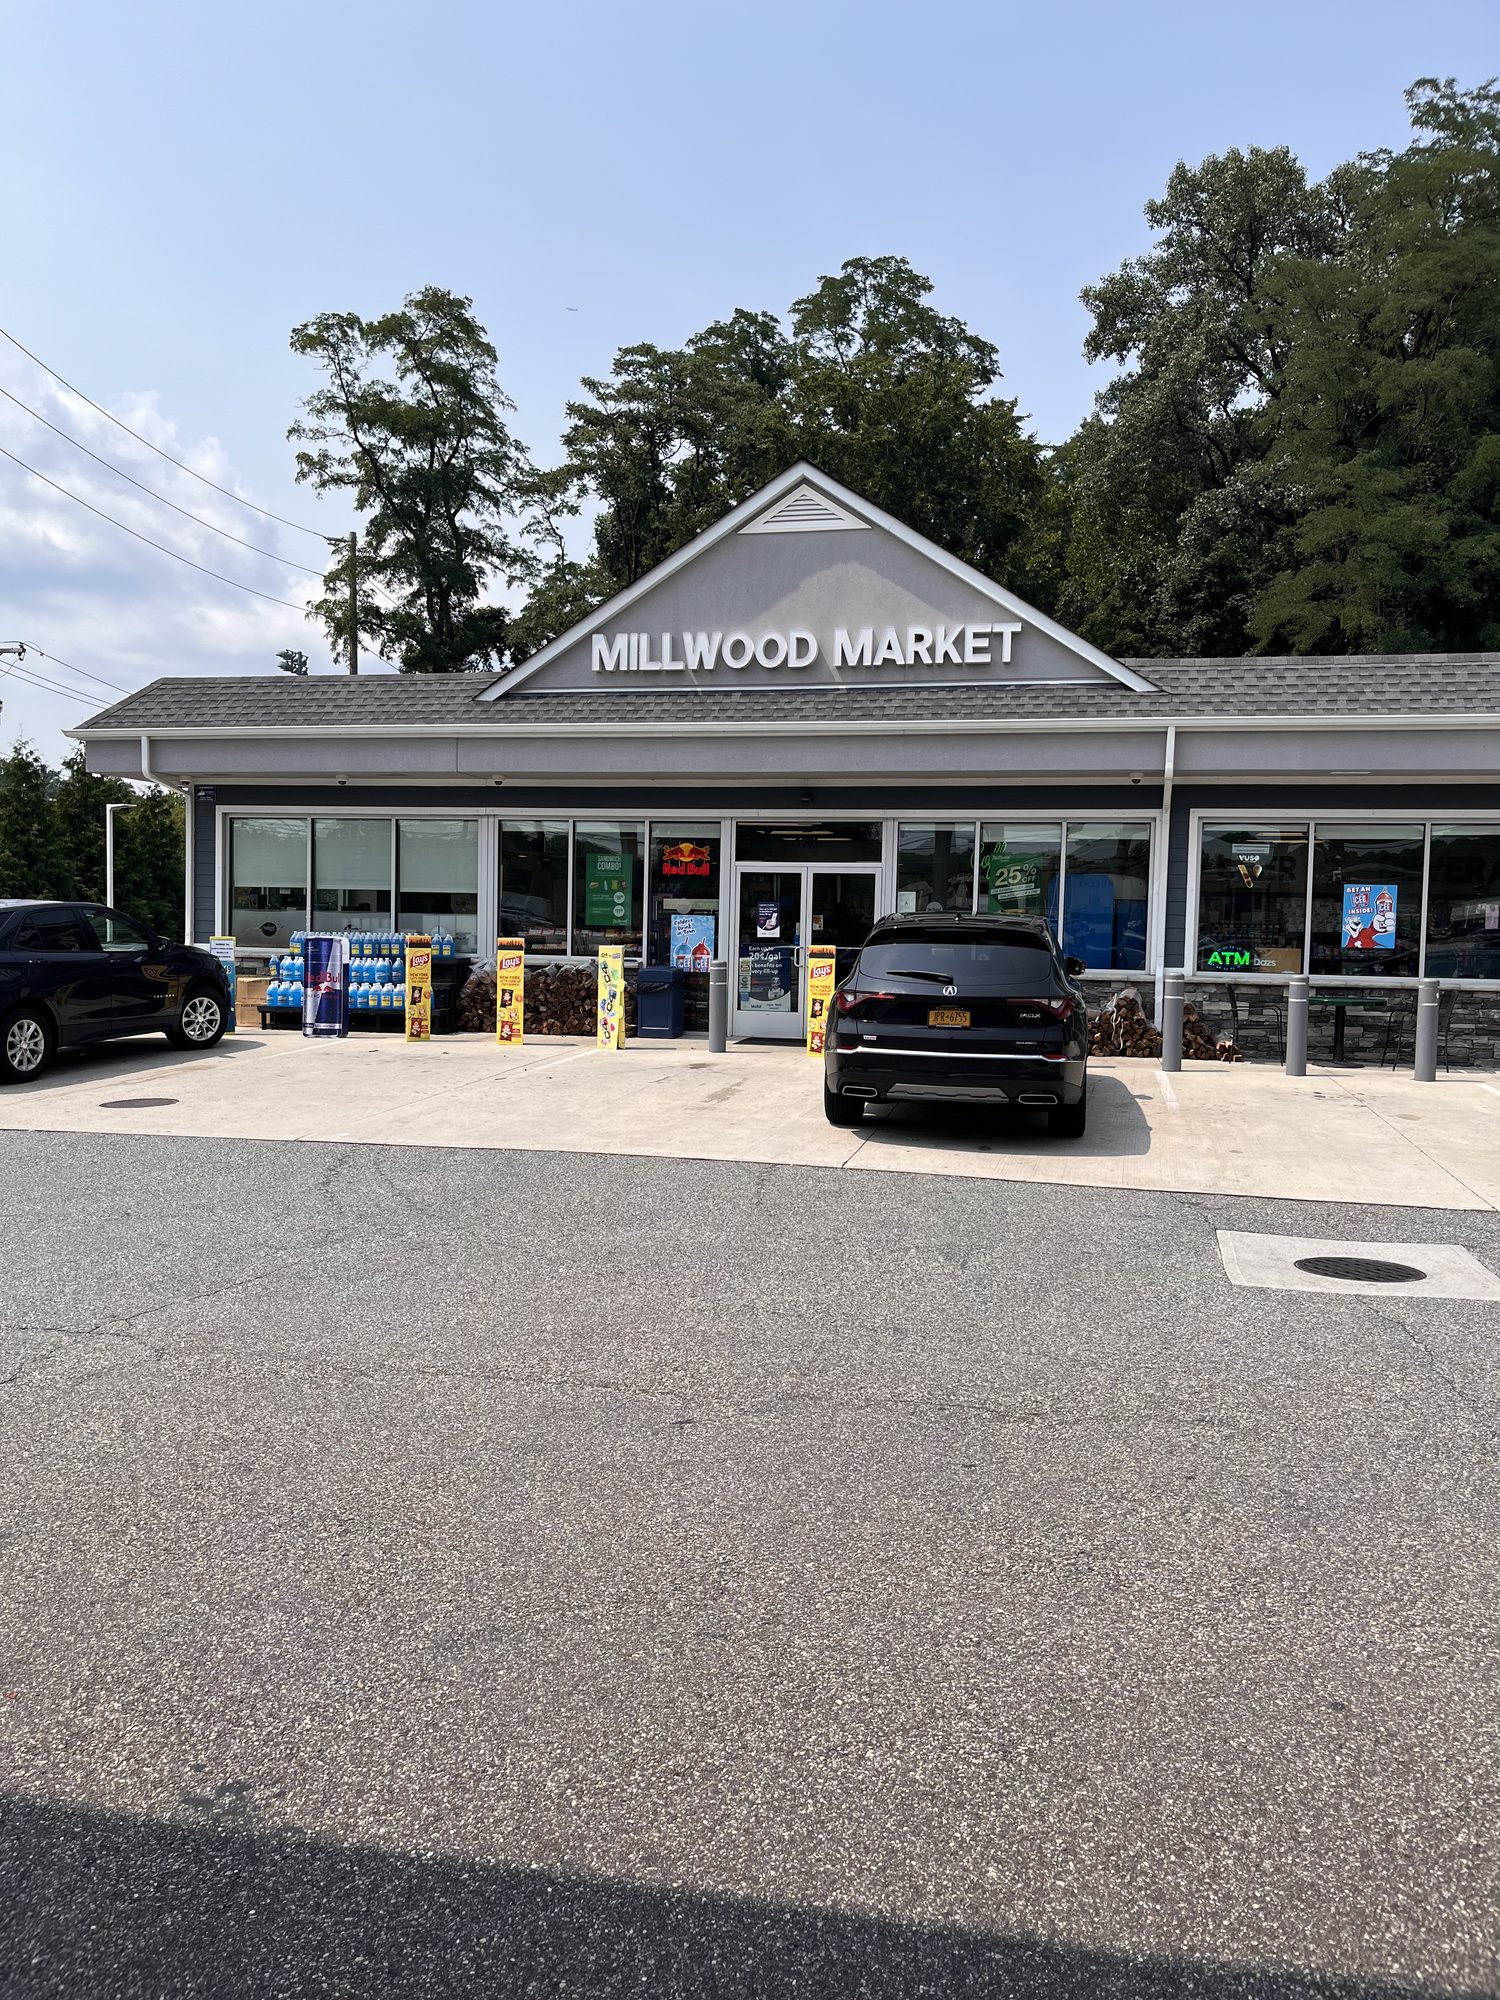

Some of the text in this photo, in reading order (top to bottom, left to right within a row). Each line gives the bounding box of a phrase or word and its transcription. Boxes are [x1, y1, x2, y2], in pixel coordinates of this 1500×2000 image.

[591, 622, 1022, 672] MILLWOOD MARKET
[663, 863, 710, 875] Red Bull
[1022, 875, 1037, 883] OFF
[1348, 907, 1373, 915] INSIDE!
[412, 954, 428, 966] Lay's
[502, 957, 520, 969] Lay's
[749, 952, 781, 962] 20¢/gal
[1207, 951, 1250, 966] ATM
[813, 965, 831, 977] Lay's
[326, 972, 340, 983] Bul
[932, 1012, 967, 1022] JPR 6755
